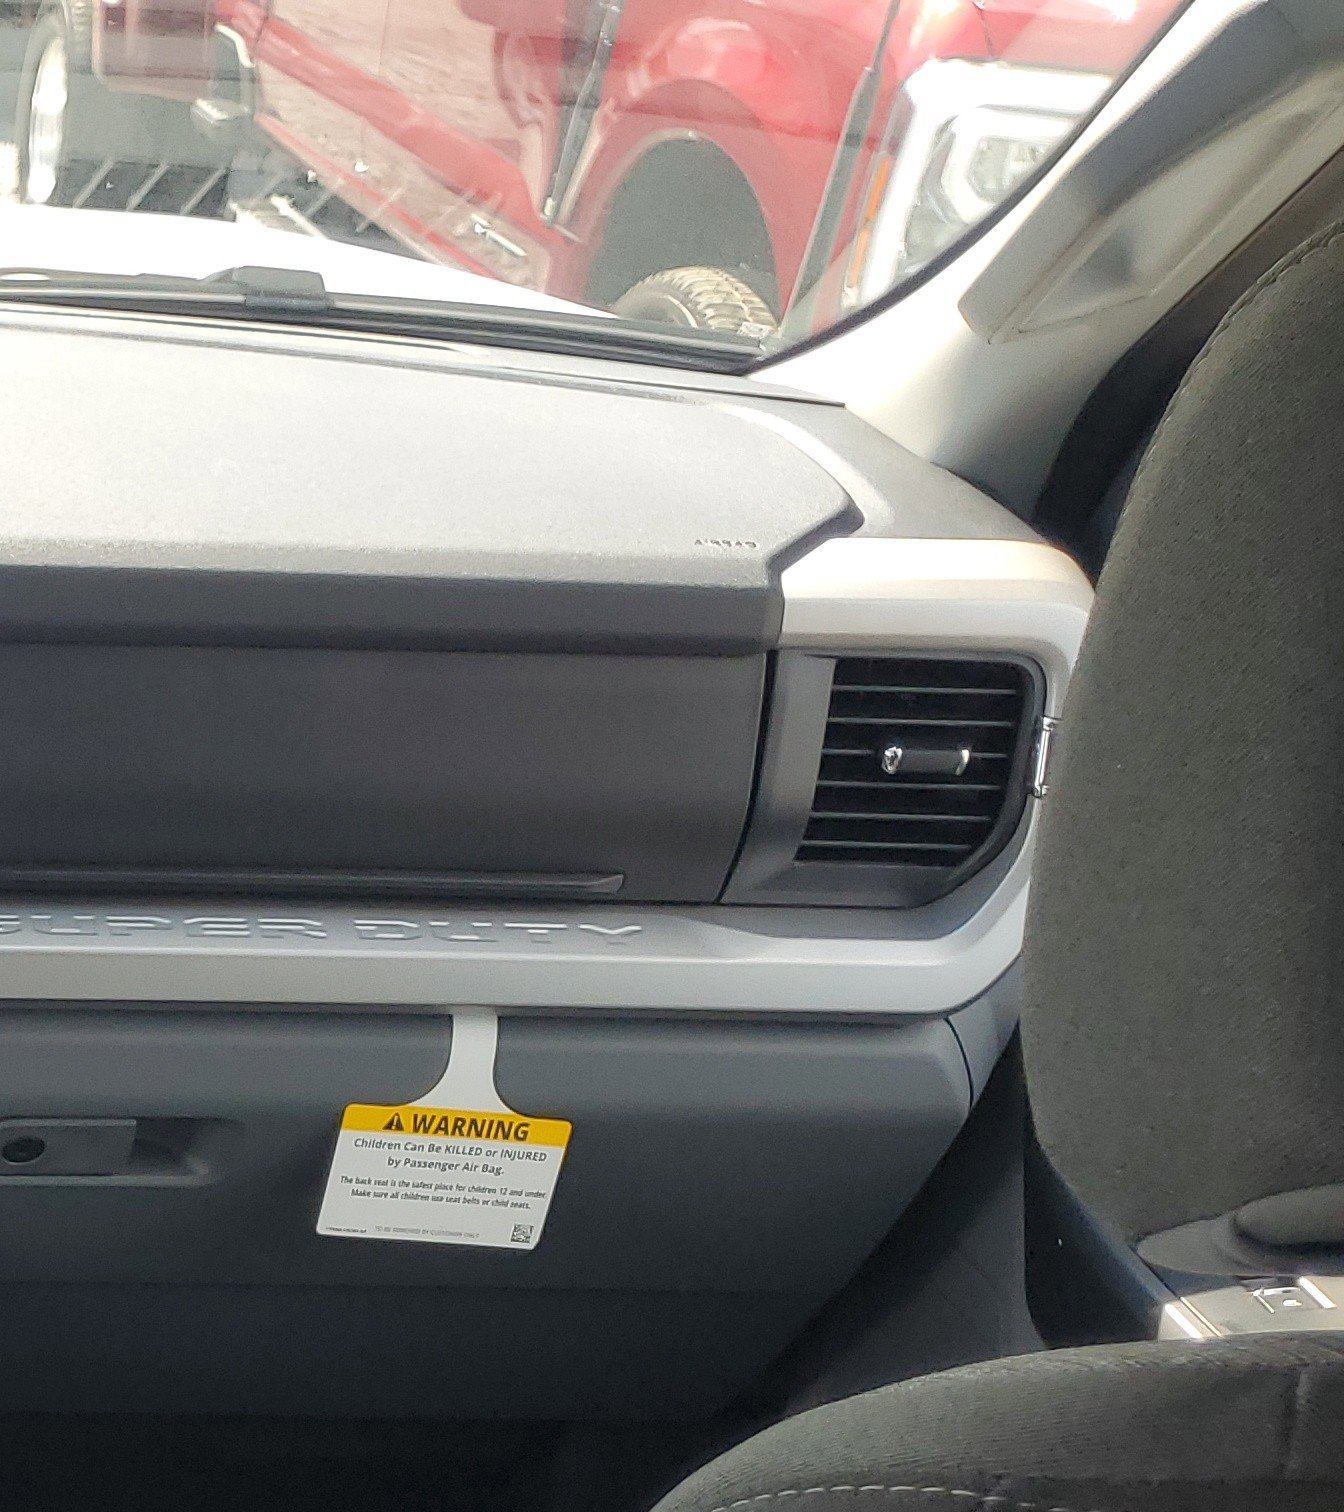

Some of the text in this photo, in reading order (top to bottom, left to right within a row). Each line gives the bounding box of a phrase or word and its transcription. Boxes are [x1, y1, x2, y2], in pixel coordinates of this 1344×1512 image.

[352, 917, 644, 946] DUTY
[412, 1113, 531, 1142] WARNING
[354, 1137, 548, 1162] Children Can Be KILLED or INJURED
[387, 1156, 505, 1176] by Passenger Air Bag.
[340, 1175, 353, 1184] The
[398, 1180, 410, 1188] the
[412, 1181, 433, 1190] safest
[434, 1183, 454, 1192] place
[455, 1184, 466, 1192] for
[467, 1185, 497, 1194] children
[499, 1187, 508, 1196] 12
[508, 1189, 524, 1197] and
[351, 1188, 372, 1198] Make
[400, 1192, 430, 1202] children
[462, 1197, 480, 1205] belts
[492, 1199, 510, 1208] child
